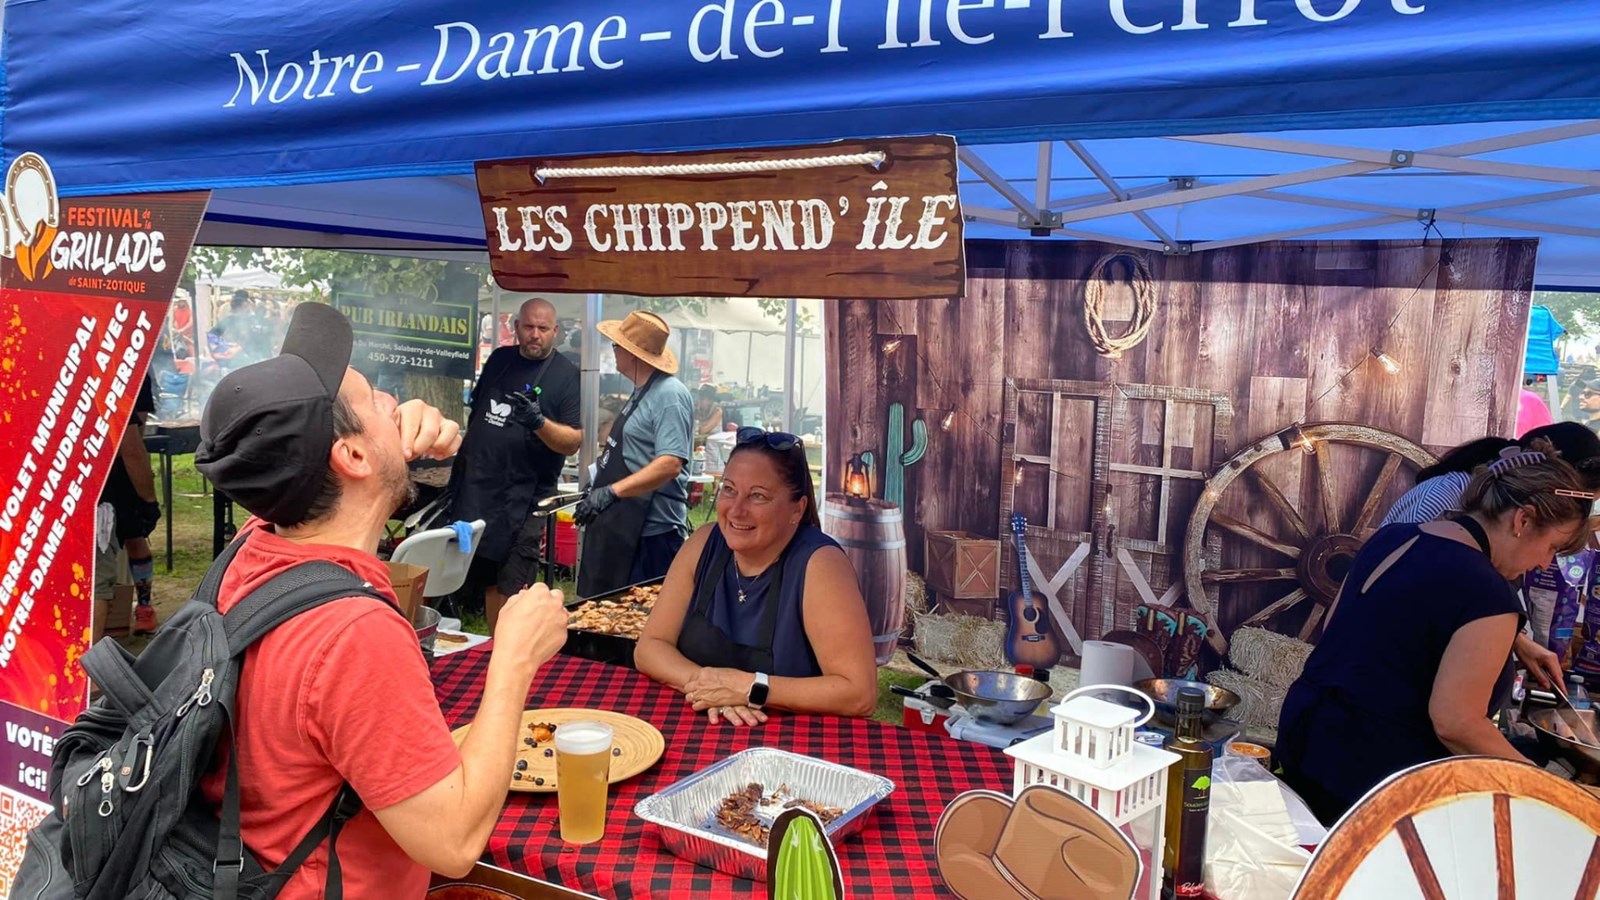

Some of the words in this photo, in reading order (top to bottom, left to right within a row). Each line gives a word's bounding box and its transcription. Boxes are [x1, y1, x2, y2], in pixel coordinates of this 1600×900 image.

[67, 207, 142, 228] FESTIVAL
[492, 204, 573, 252] LES
[50, 231, 167, 276] GRILLADE
[77, 277, 146, 294] SAINT-ZOTIQUE
[95, 301, 130, 373] AVEC
[341, 305, 374, 325] PUB
[377, 308, 468, 336] IRLANDAIS
[367, 352, 434, 369] 450-373-1211
[393, 343, 470, 360] Salaberry-de-Valleyfield
[0, 451, 38, 532] VOLET
[31, 315, 98, 455] MUNICIPAL
[5, 721, 58, 757] VOTE
